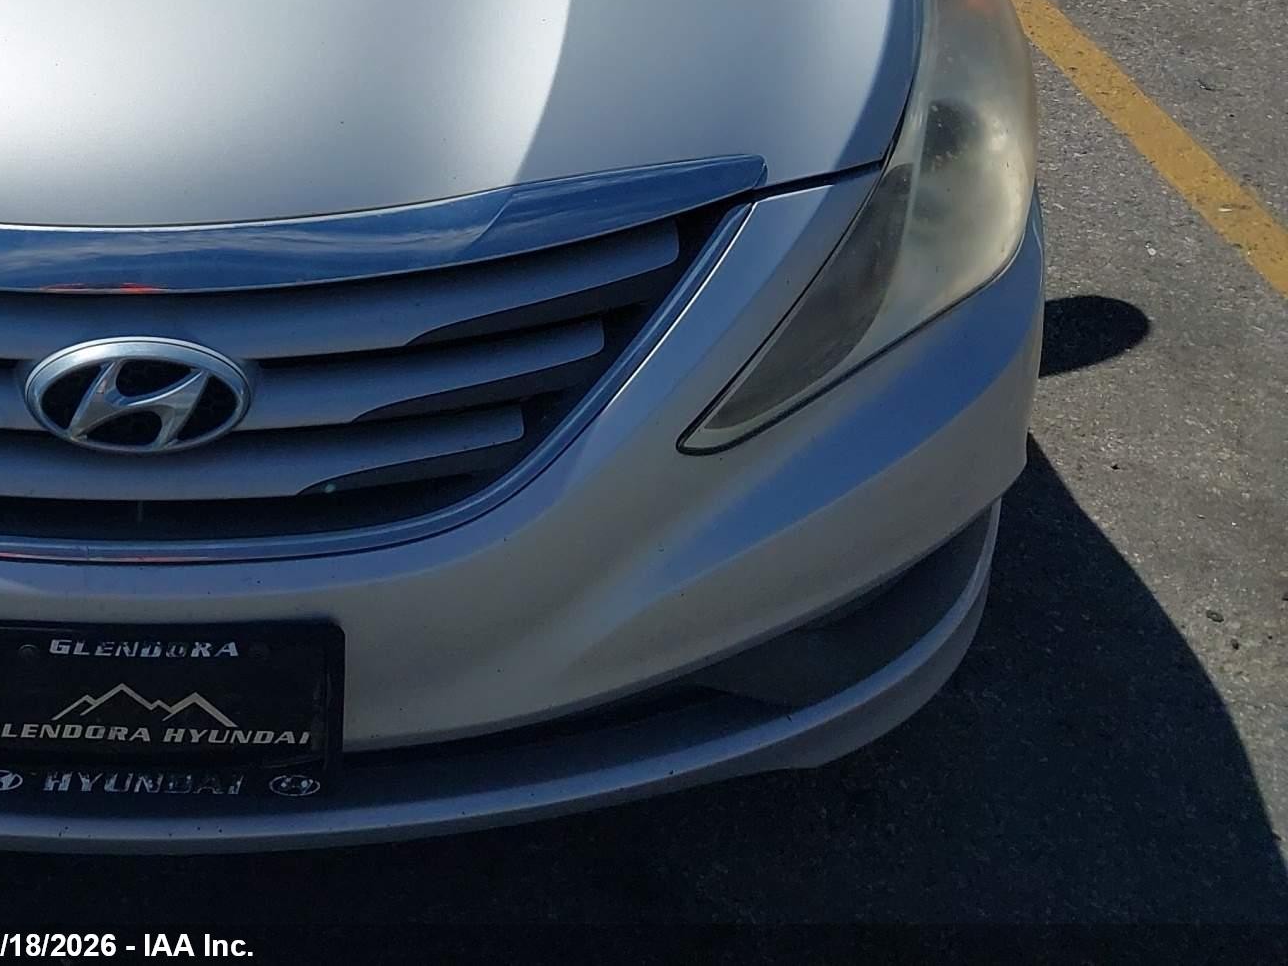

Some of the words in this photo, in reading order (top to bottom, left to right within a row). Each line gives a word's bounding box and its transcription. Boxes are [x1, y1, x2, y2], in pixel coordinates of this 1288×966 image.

[49, 639, 239, 658] GLENDORA
[163, 728, 311, 745] HYUNDAI
[42, 771, 245, 795] HYUNDAI
